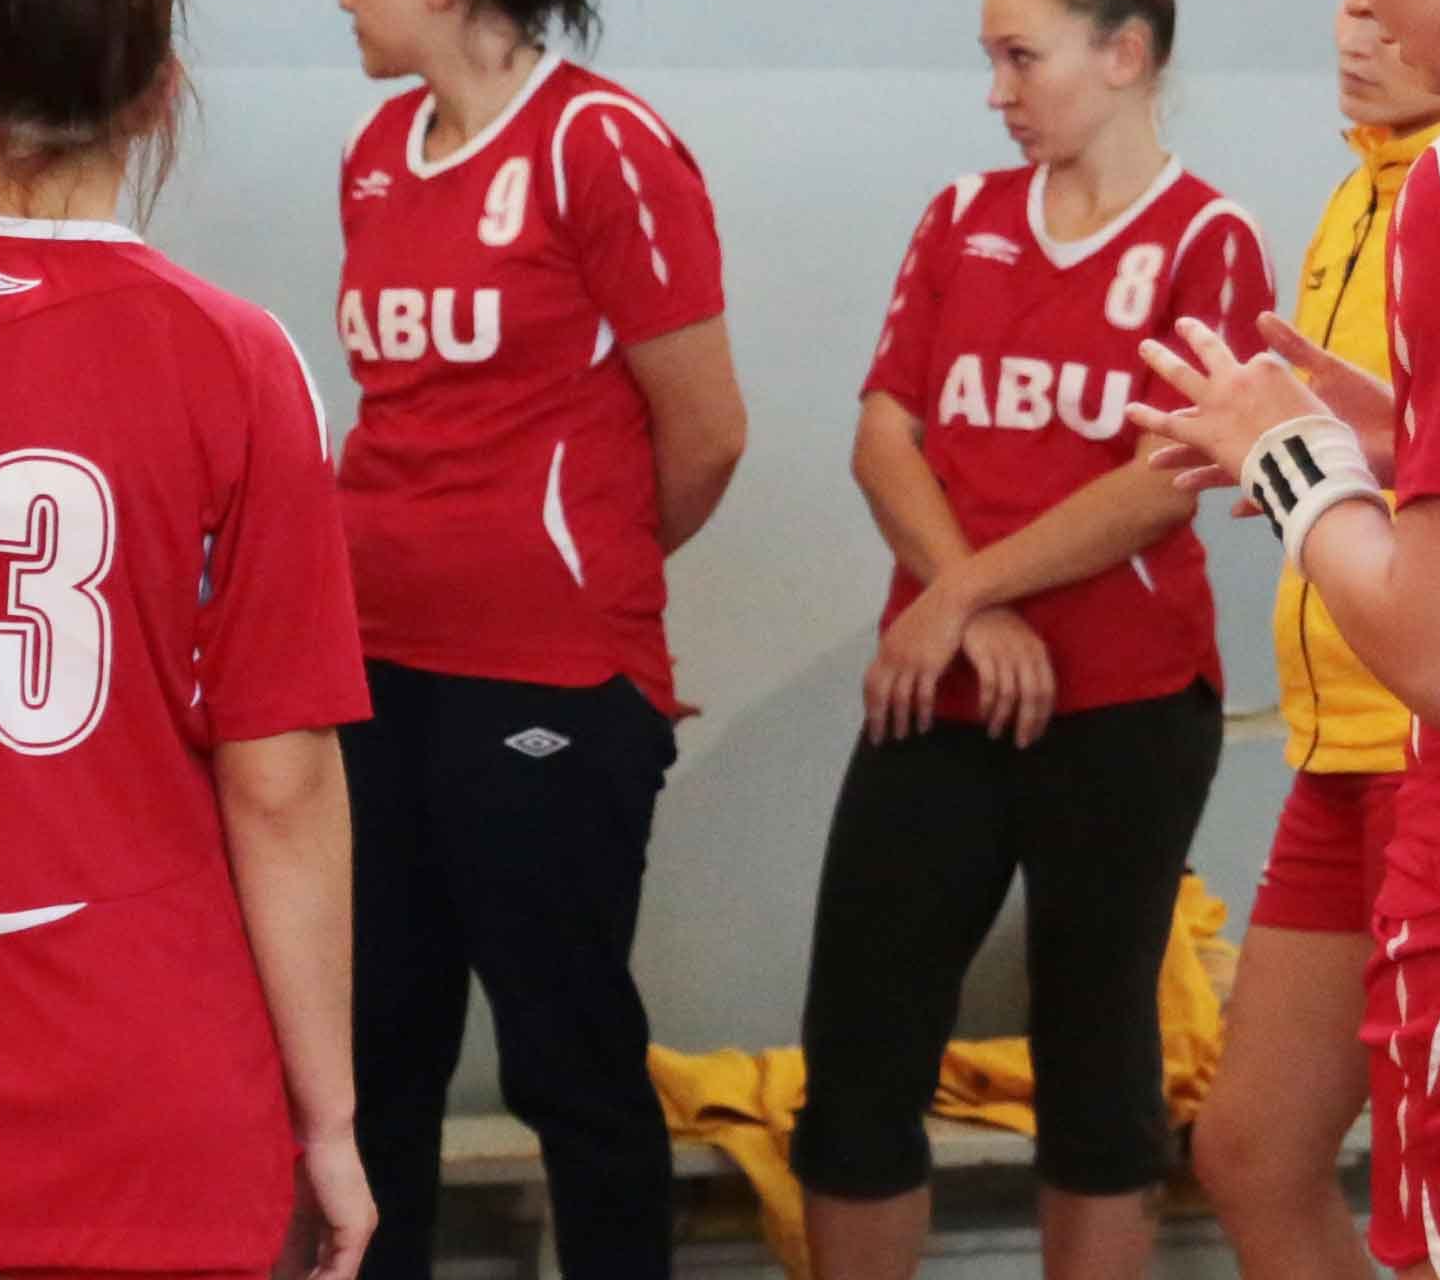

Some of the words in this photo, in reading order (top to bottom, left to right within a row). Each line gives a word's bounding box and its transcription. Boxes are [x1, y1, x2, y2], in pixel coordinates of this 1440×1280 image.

[477, 156, 531, 247] 9
[338, 287, 502, 363] ABU
[1105, 242, 1164, 330] 8
[937, 353, 1133, 441] ABU
